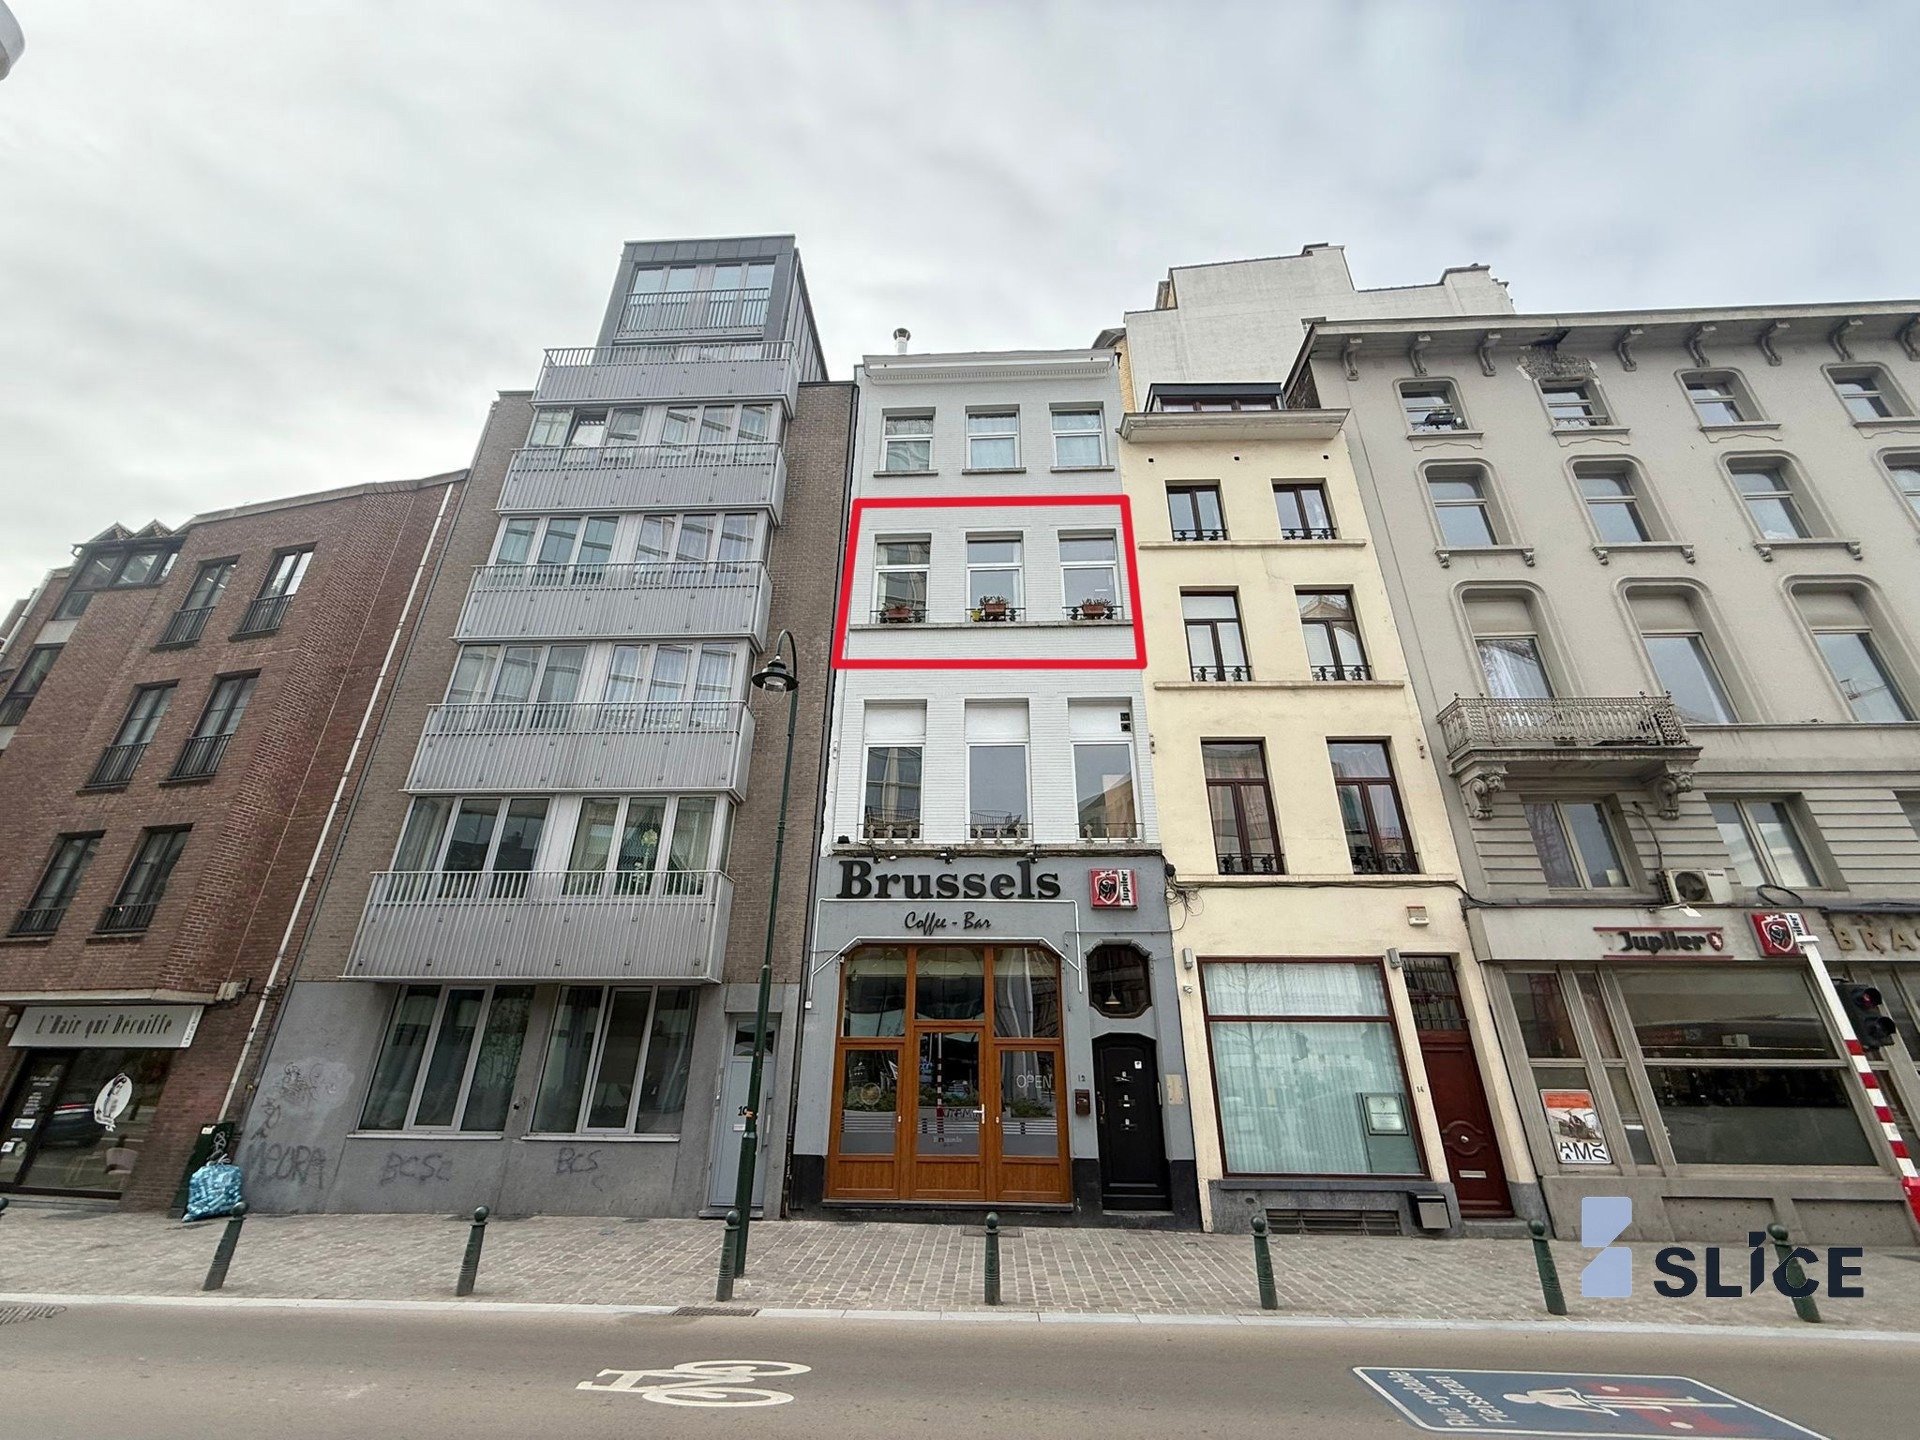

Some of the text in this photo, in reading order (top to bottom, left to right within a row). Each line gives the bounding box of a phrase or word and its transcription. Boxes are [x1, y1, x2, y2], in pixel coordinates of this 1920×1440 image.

[836, 860, 1061, 899] Brussels
[1120, 871, 1131, 904] Jupiler
[905, 911, 947, 936] Coffee
[963, 911, 991, 930] Bar
[1831, 927, 1920, 951] BRA
[85, 1014, 111, 1039] qui
[1016, 1074, 1053, 1089] OPEN
